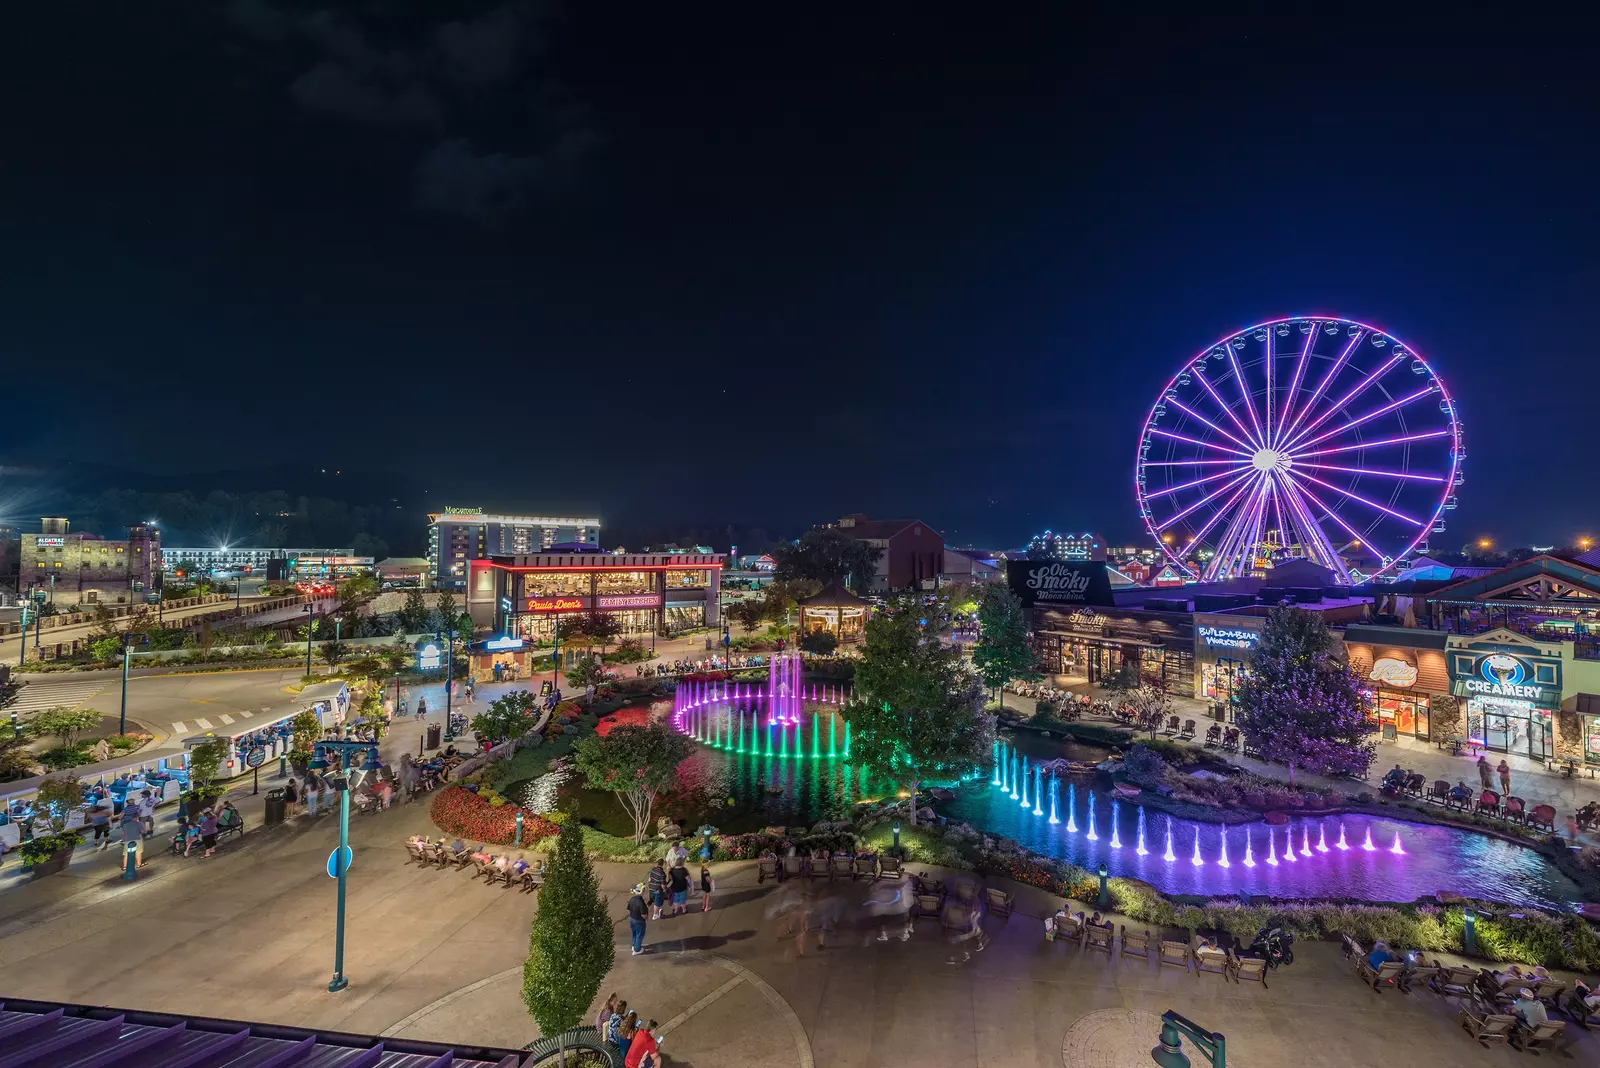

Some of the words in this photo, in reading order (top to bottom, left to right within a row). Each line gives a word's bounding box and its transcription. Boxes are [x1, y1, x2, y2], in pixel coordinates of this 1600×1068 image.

[1050, 563, 1073, 577] Ole
[1026, 566, 1091, 593] Smoky
[528, 599, 554, 610] Paula
[554, 599, 582, 610] Deen's
[600, 597, 627, 606] FAMILY
[627, 596, 659, 605] KITCHEN
[1068, 609, 1108, 628] Smoky
[1205, 636, 1251, 649] WORKSHOP
[1465, 679, 1543, 699] CREAMERY
